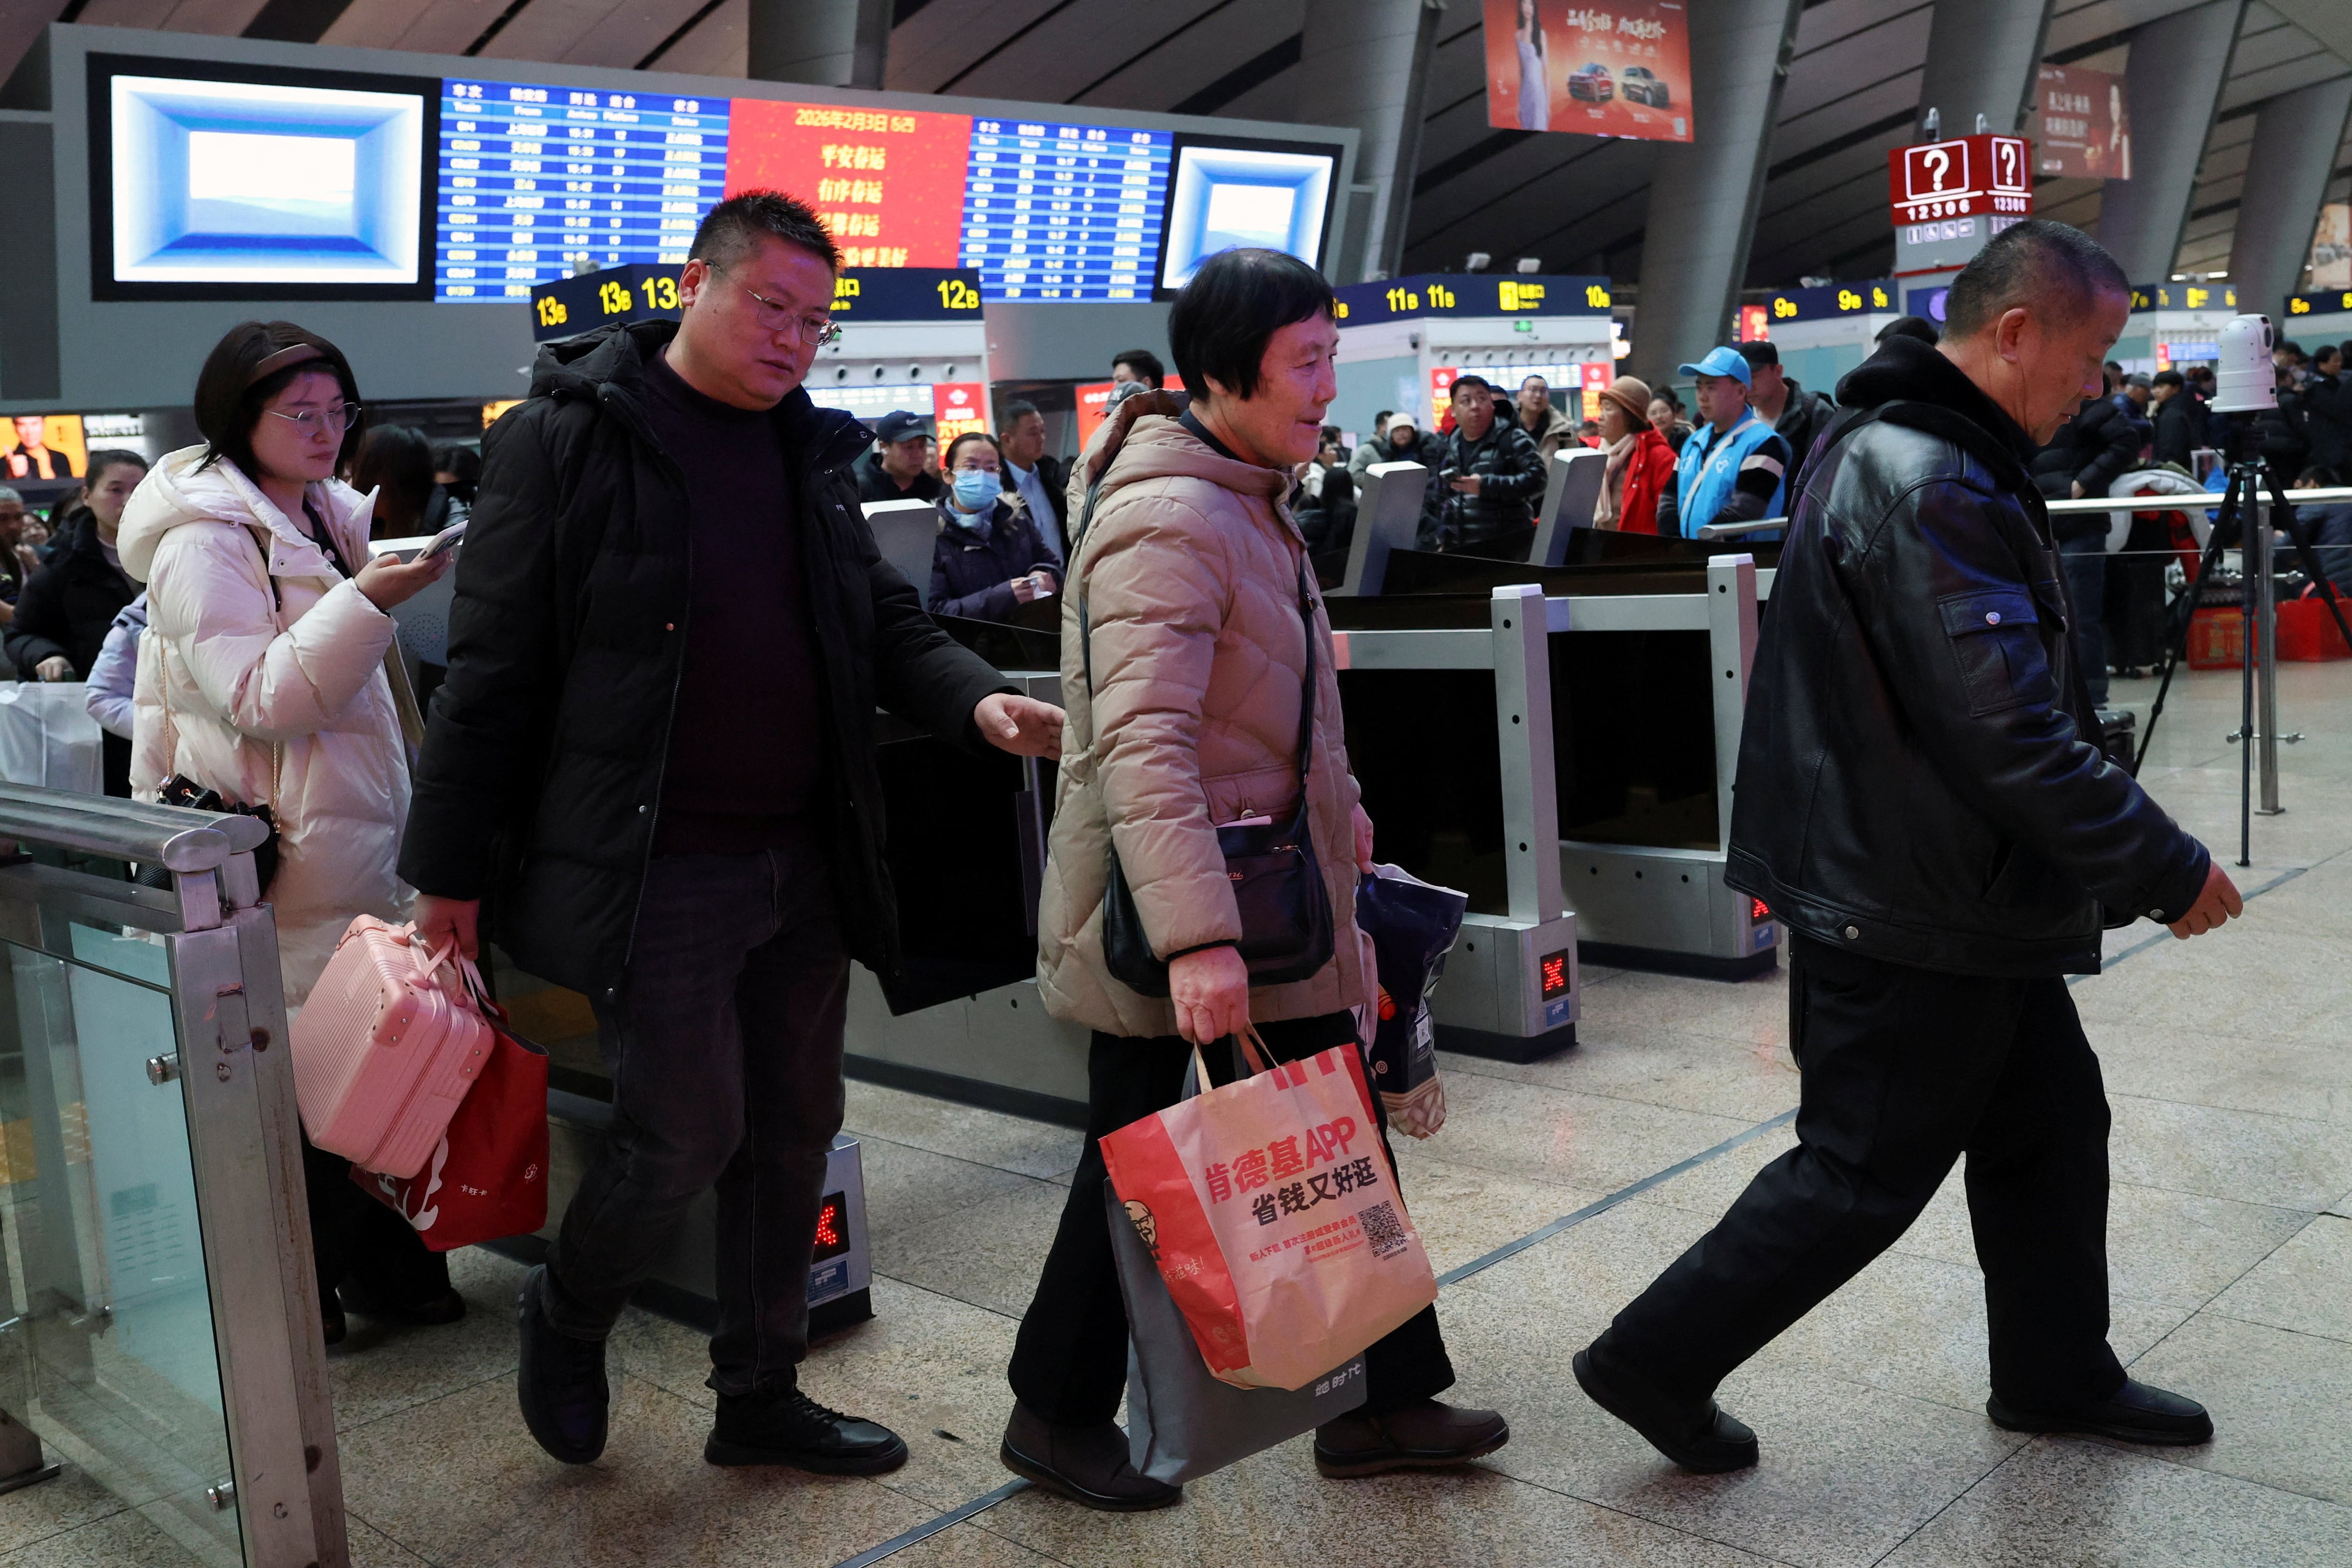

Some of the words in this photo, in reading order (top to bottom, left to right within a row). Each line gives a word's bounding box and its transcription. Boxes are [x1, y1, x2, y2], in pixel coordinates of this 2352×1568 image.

[820, 143, 886, 170] 平安春运
[818, 177, 883, 204] 有序春运
[1907, 199, 1970, 221] 12306
[1994, 197, 2026, 212] 12306
[599, 282, 631, 314] 13B
[642, 278, 684, 309] 13
[938, 280, 979, 309] 12B
[1386, 287, 1419, 312] 11B
[1427, 285, 1455, 308] 11B
[1586, 286, 1610, 308] 10B
[1838, 289, 1862, 310] 9B
[537, 296, 567, 326] 13B
[1774, 297, 1797, 318] 9B
[461, 1184, 487, 1196] 卡旺卡
[1252, 1156, 1377, 1226] 省钱又好逛
[1249, 1243, 1281, 1262] 新人下载
